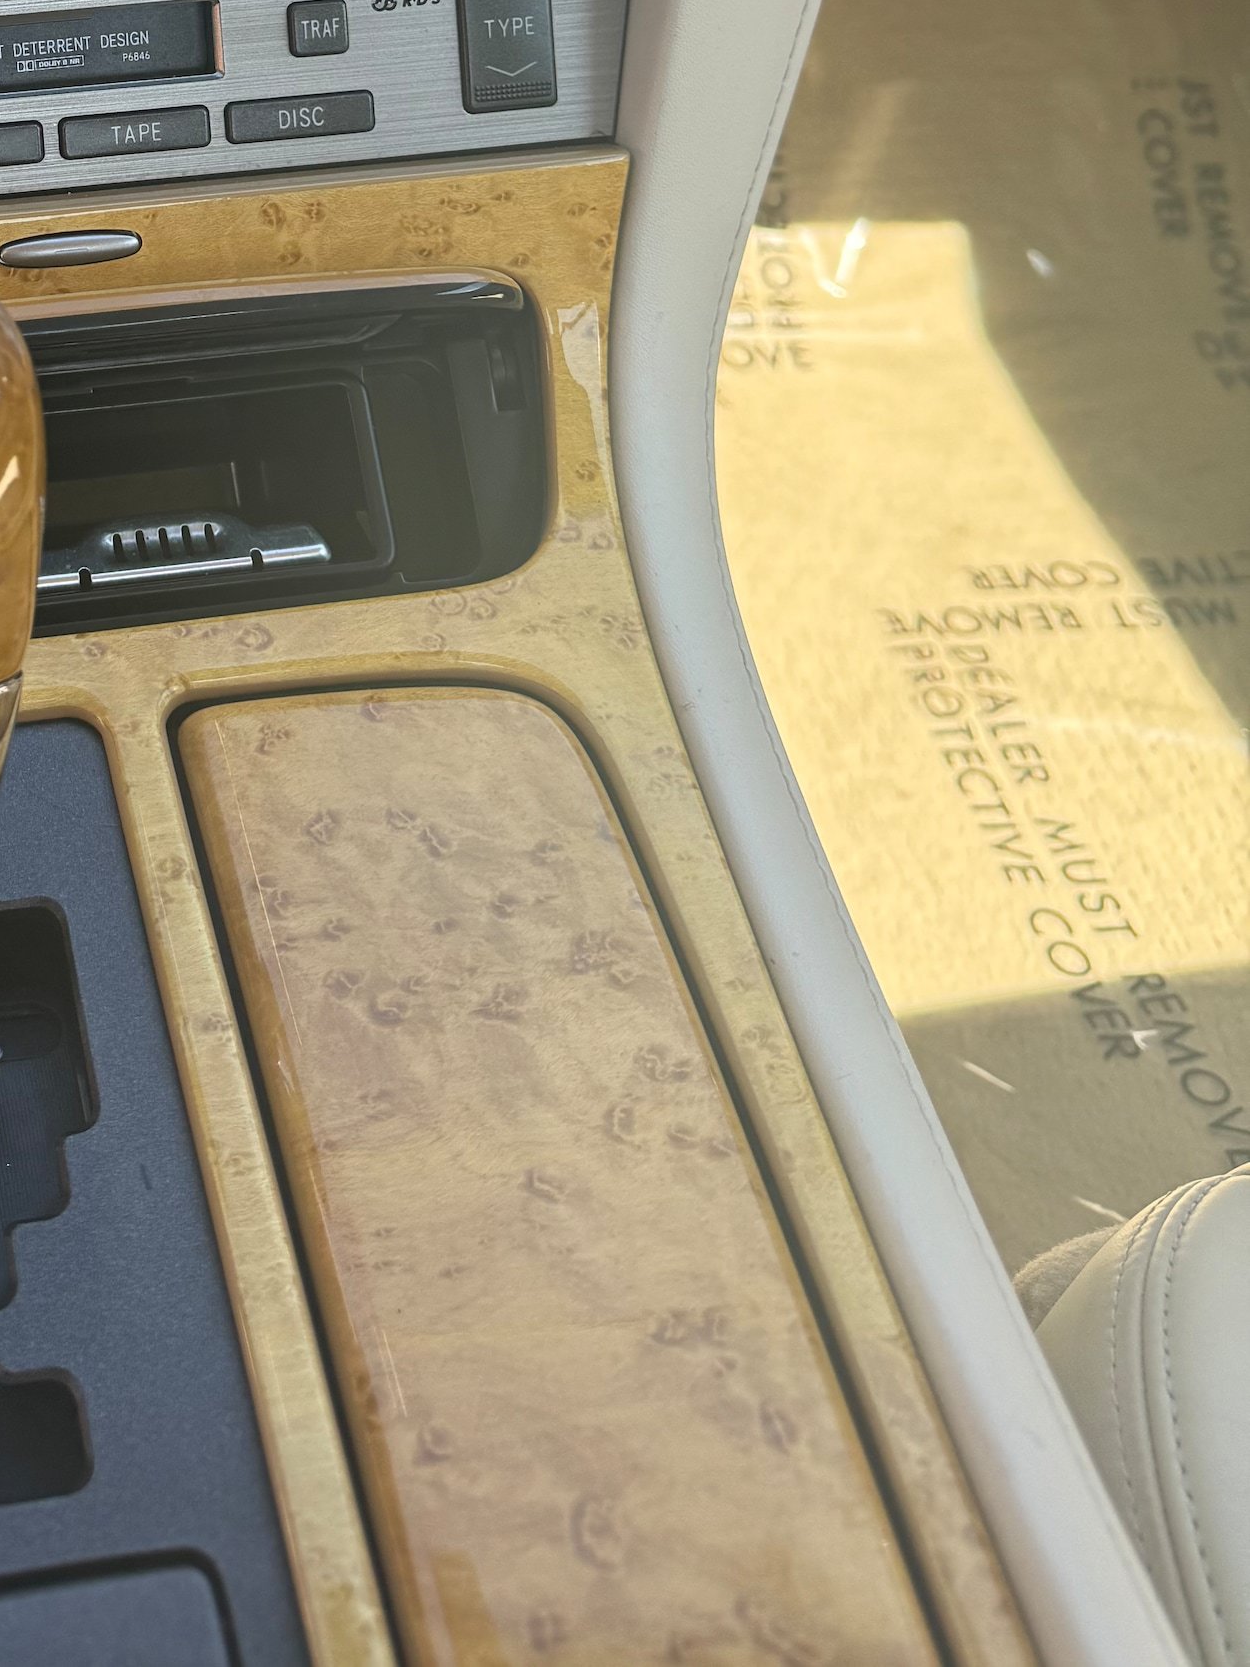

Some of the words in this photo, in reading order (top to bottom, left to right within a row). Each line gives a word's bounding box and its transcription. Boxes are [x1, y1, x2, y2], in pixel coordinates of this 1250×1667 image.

[300, 18, 340, 40] TRAF
[484, 16, 536, 39] TYPE
[12, 35, 92, 58] DETERRENT
[100, 30, 151, 49] DESIGN
[122, 50, 151, 62] P6846
[277, 105, 325, 130] DISC
[110, 122, 163, 146] TAPE
[972, 559, 1121, 592] COVER
[947, 642, 1051, 787] DEALER
[1033, 816, 1138, 940] MUST
[889, 640, 1045, 887] PROTECTIVE
[1028, 907, 1143, 1062] COVER
